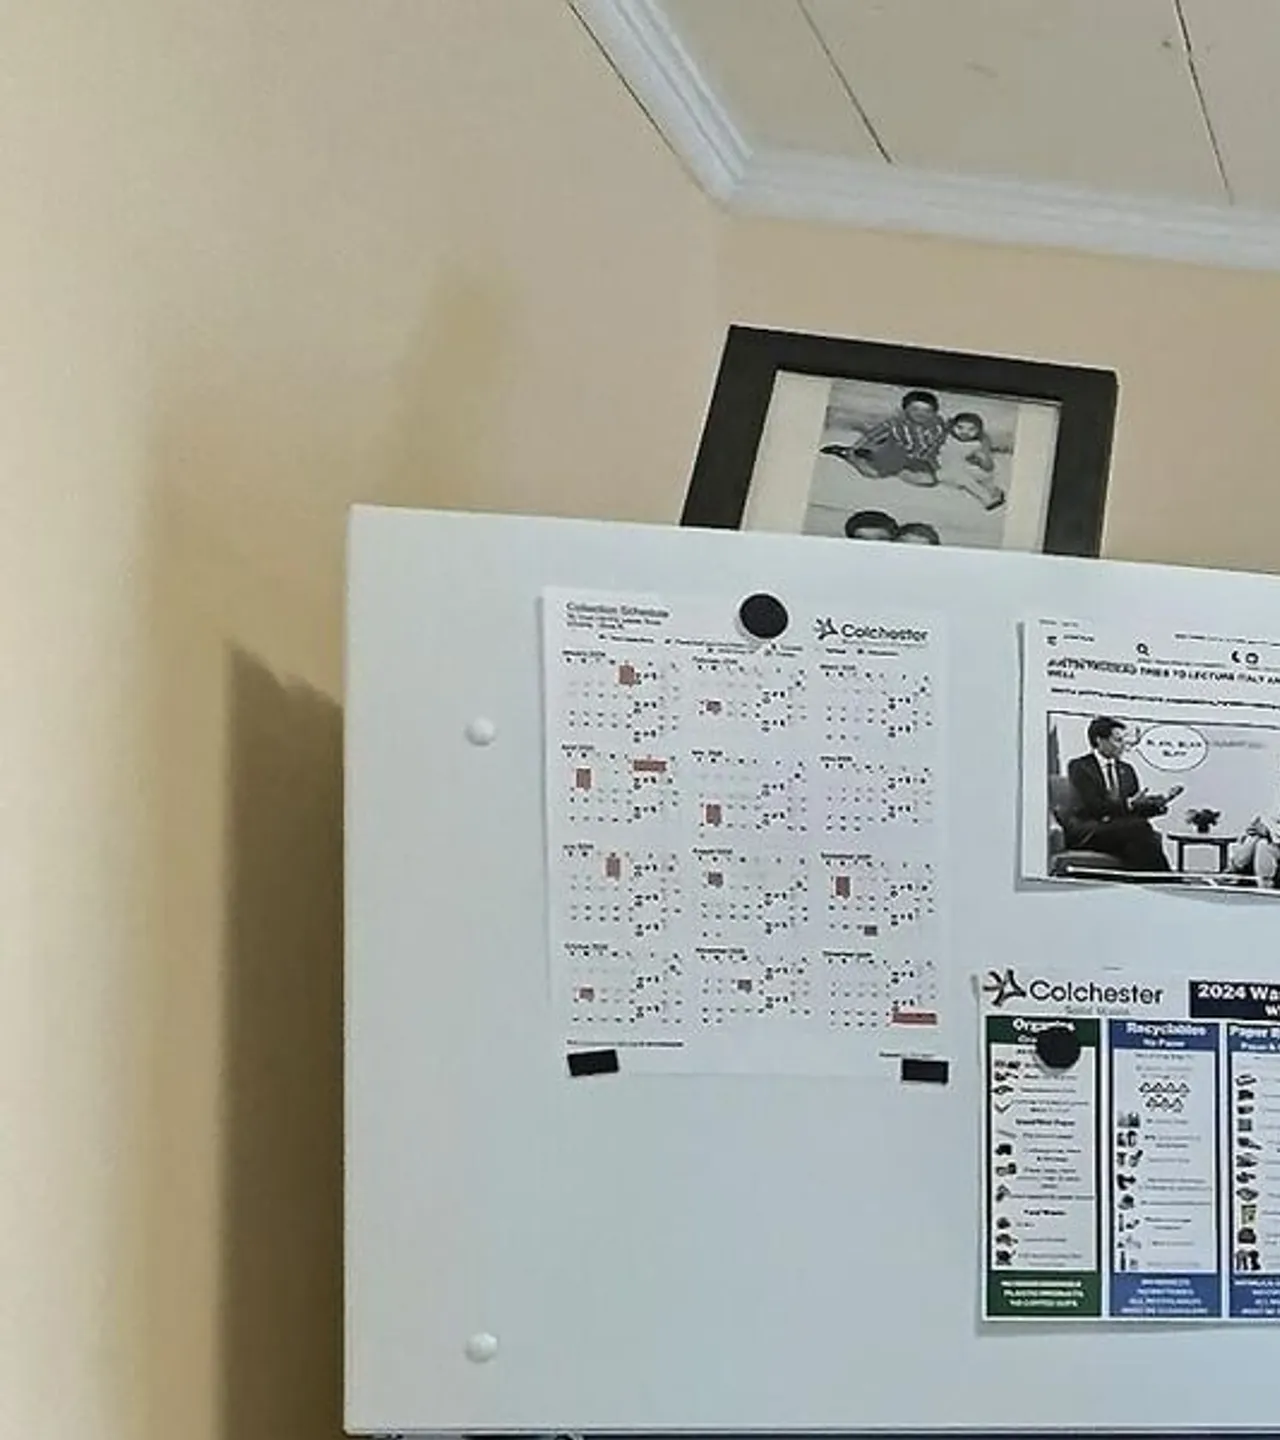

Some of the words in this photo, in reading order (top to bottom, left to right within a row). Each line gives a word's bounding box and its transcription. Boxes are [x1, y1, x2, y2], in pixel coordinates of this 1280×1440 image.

[840, 622, 928, 641] Colchester
[1029, 979, 1164, 1004] Colchester
[1198, 984, 1246, 1000] 2024
[1126, 1022, 1207, 1037] Recyclables
[1229, 1025, 1269, 1040] Paper
